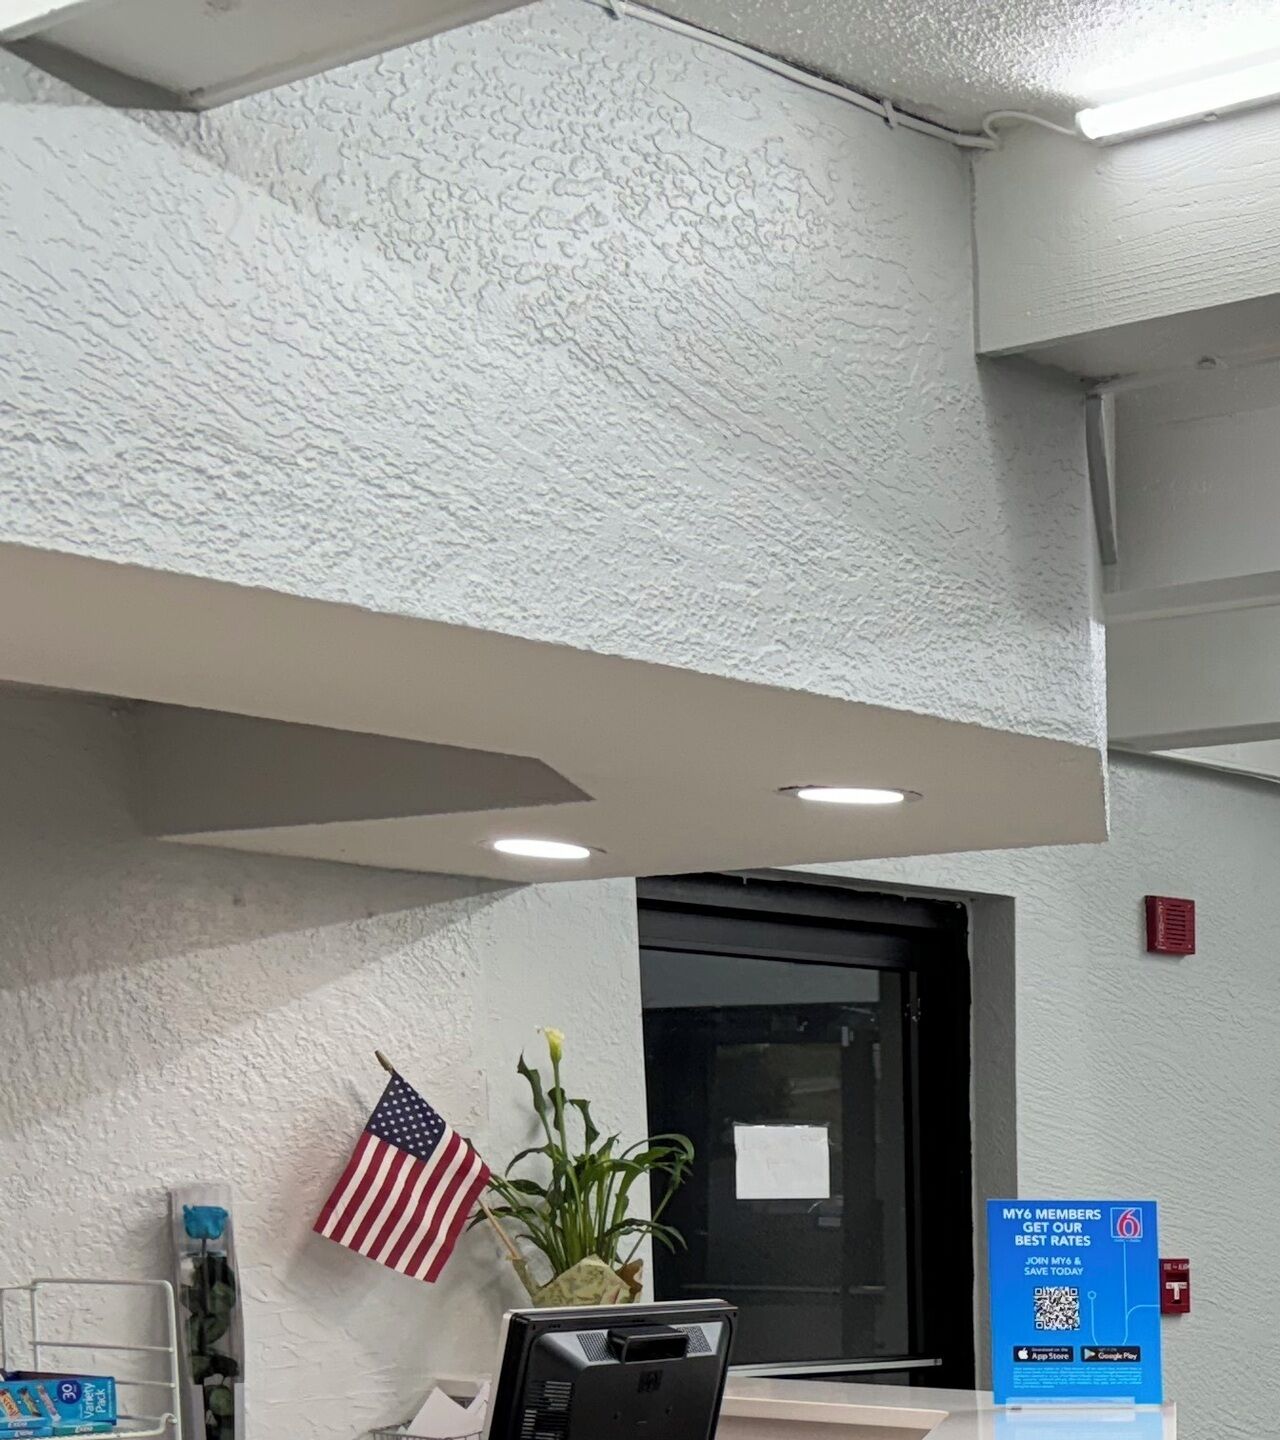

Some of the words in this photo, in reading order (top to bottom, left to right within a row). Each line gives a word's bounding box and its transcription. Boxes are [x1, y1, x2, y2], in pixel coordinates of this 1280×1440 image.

[1002, 1208, 1032, 1220] MY6
[1035, 1208, 1102, 1221] MEMBERS
[1022, 1221, 1049, 1233] GET
[1052, 1221, 1083, 1233] OUR
[1116, 1207, 1141, 1239] 6
[1014, 1234, 1047, 1247] BEST
[1050, 1235, 1092, 1247] RATES
[1024, 1256, 1049, 1266] JOIN
[1050, 1256, 1073, 1266] MY6
[1073, 1256, 1082, 1266] &
[1023, 1266, 1049, 1276] SAVE
[1050, 1266, 1085, 1277] TODAY
[1031, 1351, 1049, 1361] App
[1048, 1351, 1070, 1360] Store
[1097, 1352, 1123, 1361] Google
[1122, 1352, 1138, 1361] Play
[61, 1383, 77, 1401] 30
[83, 1382, 96, 1419] Variety
[95, 1388, 106, 1414] Pack
